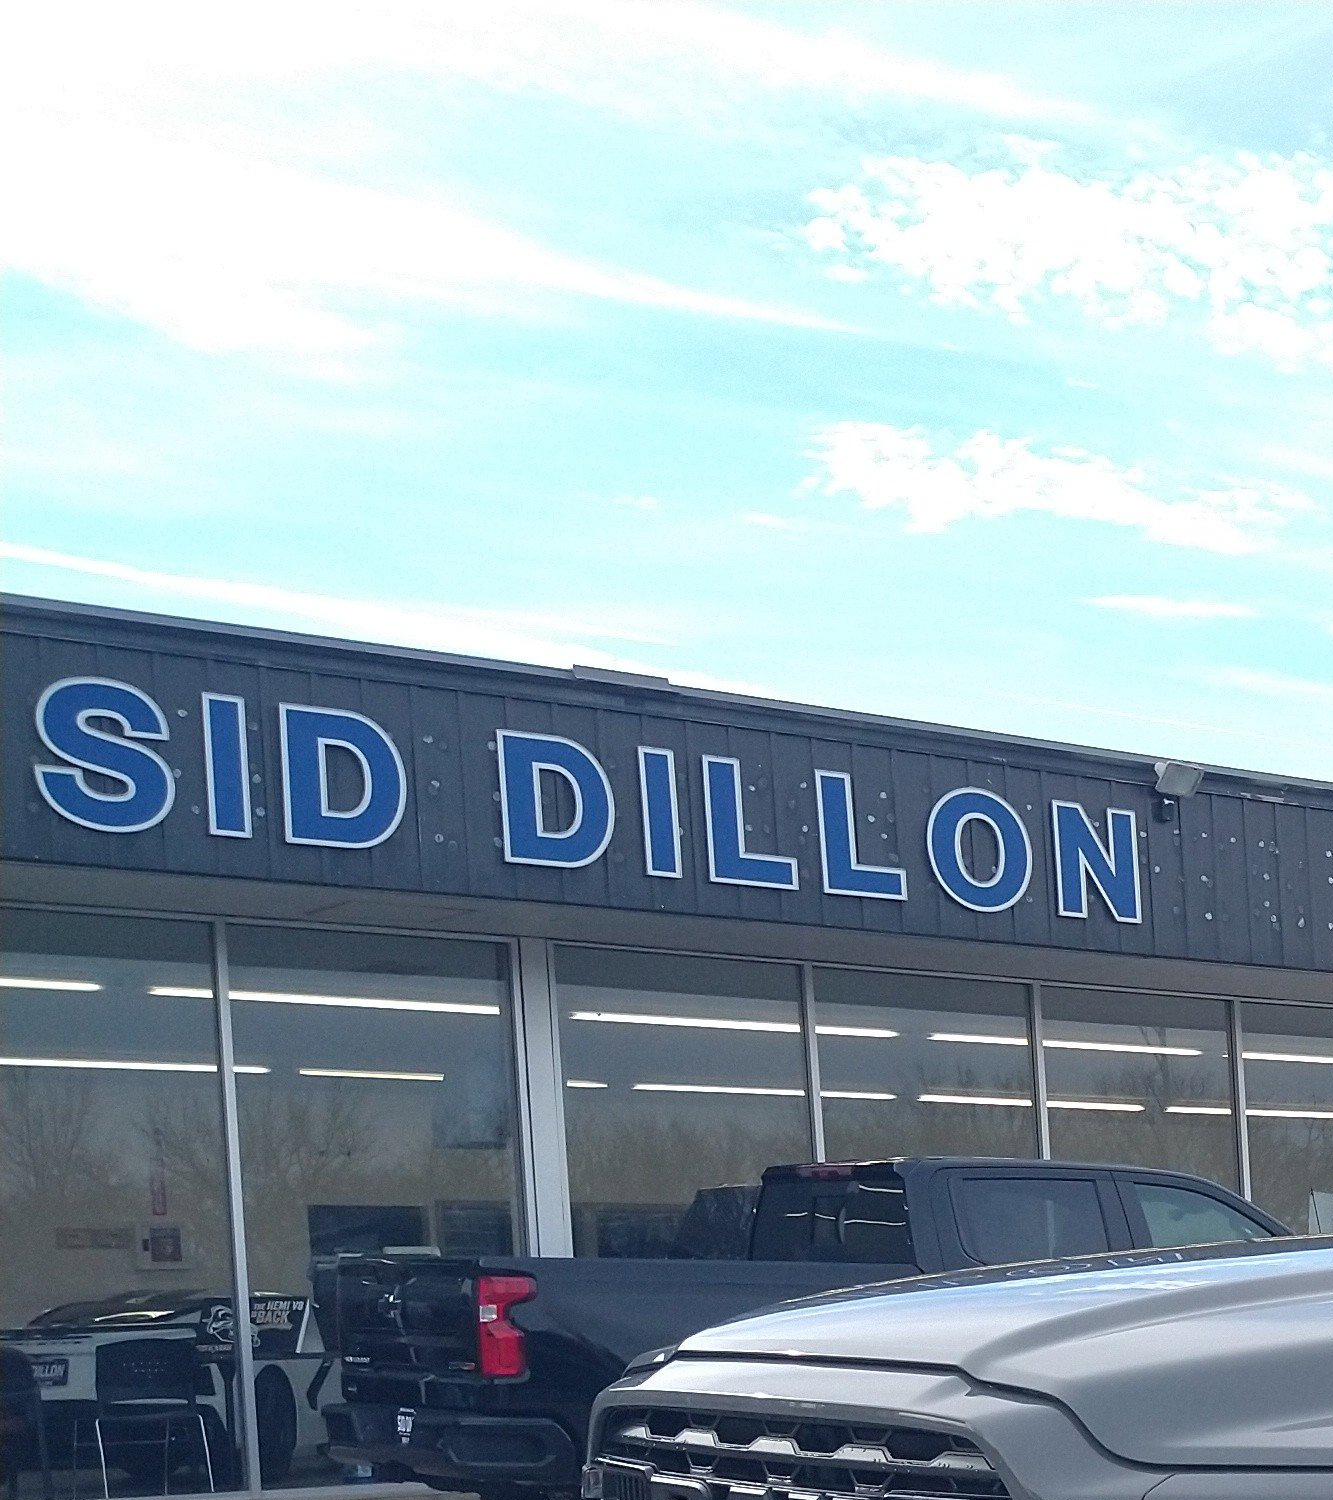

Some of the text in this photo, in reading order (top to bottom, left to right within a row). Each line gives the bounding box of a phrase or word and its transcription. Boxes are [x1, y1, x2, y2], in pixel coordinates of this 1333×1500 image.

[33, 675, 1144, 925] SID DILLON
[266, 1300, 291, 1311] HEMI
[256, 1310, 291, 1324] BACK
